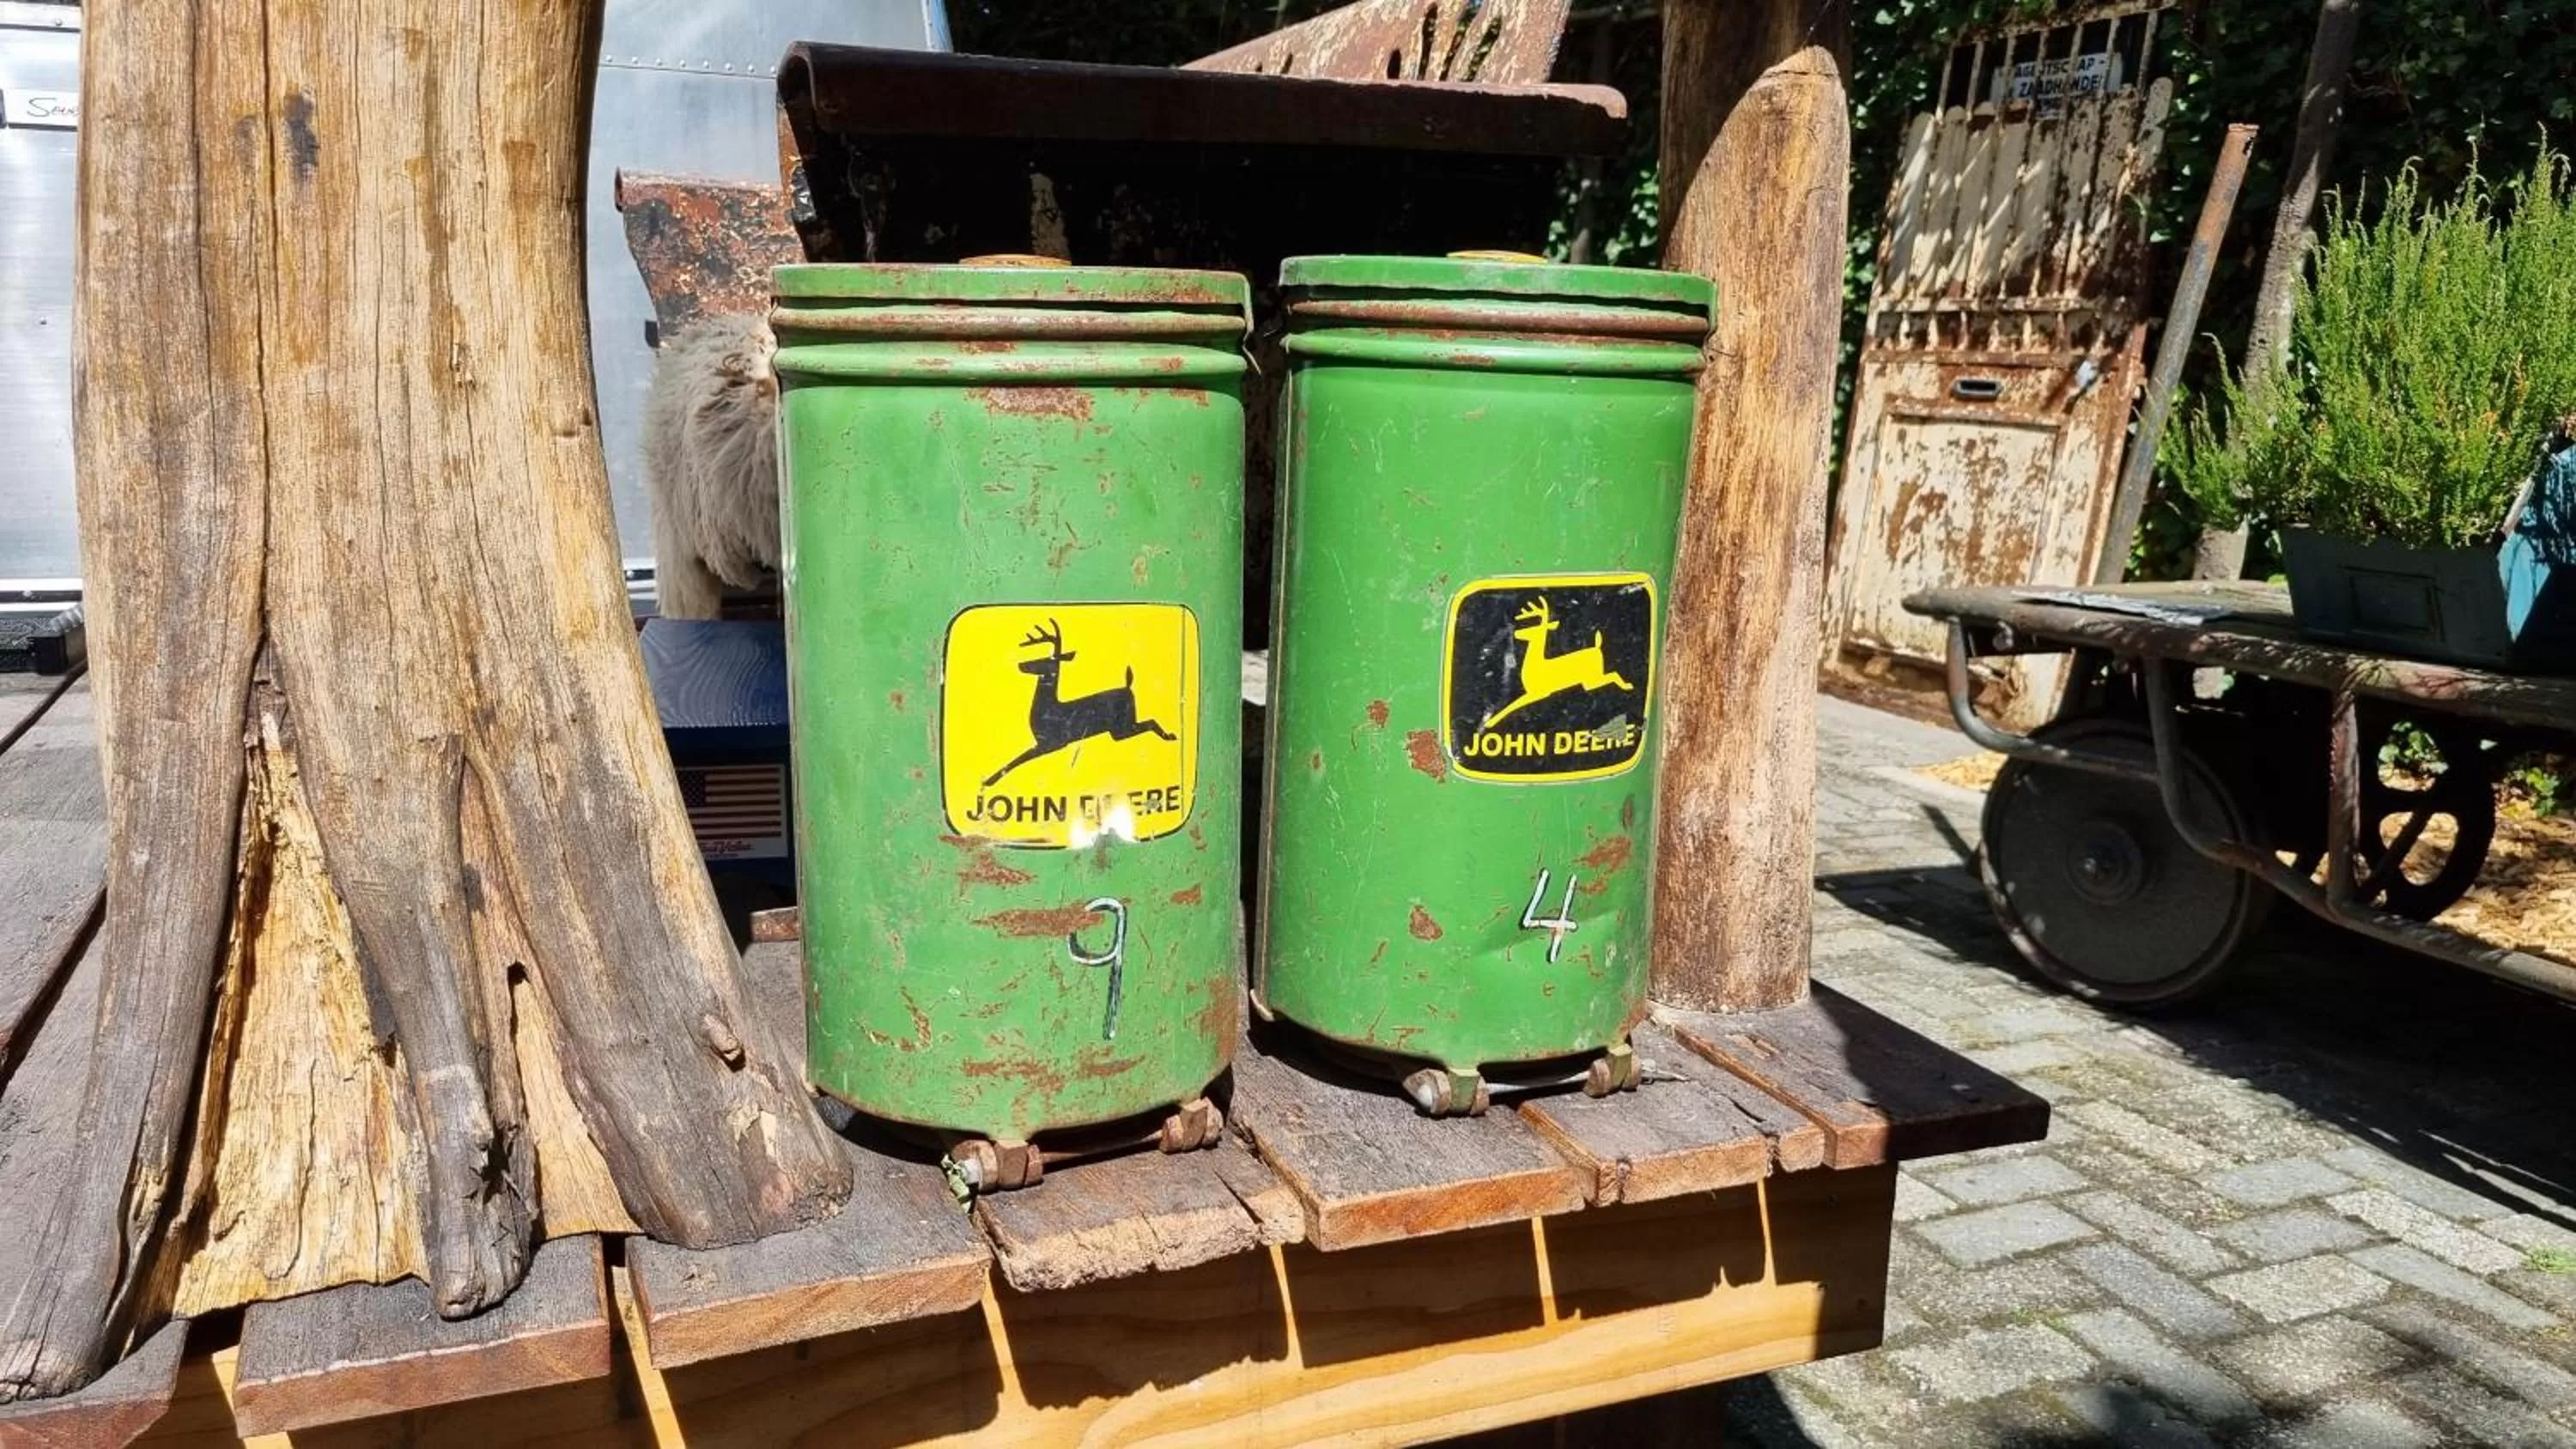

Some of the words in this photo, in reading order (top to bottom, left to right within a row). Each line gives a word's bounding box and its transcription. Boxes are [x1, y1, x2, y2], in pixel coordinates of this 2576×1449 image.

[1463, 732, 1546, 757] JOHN
[967, 795, 1067, 822] JOHN
[1079, 785, 1181, 822] DERE
[1518, 867, 1578, 963] 4
[1066, 896, 1127, 1041] 9
